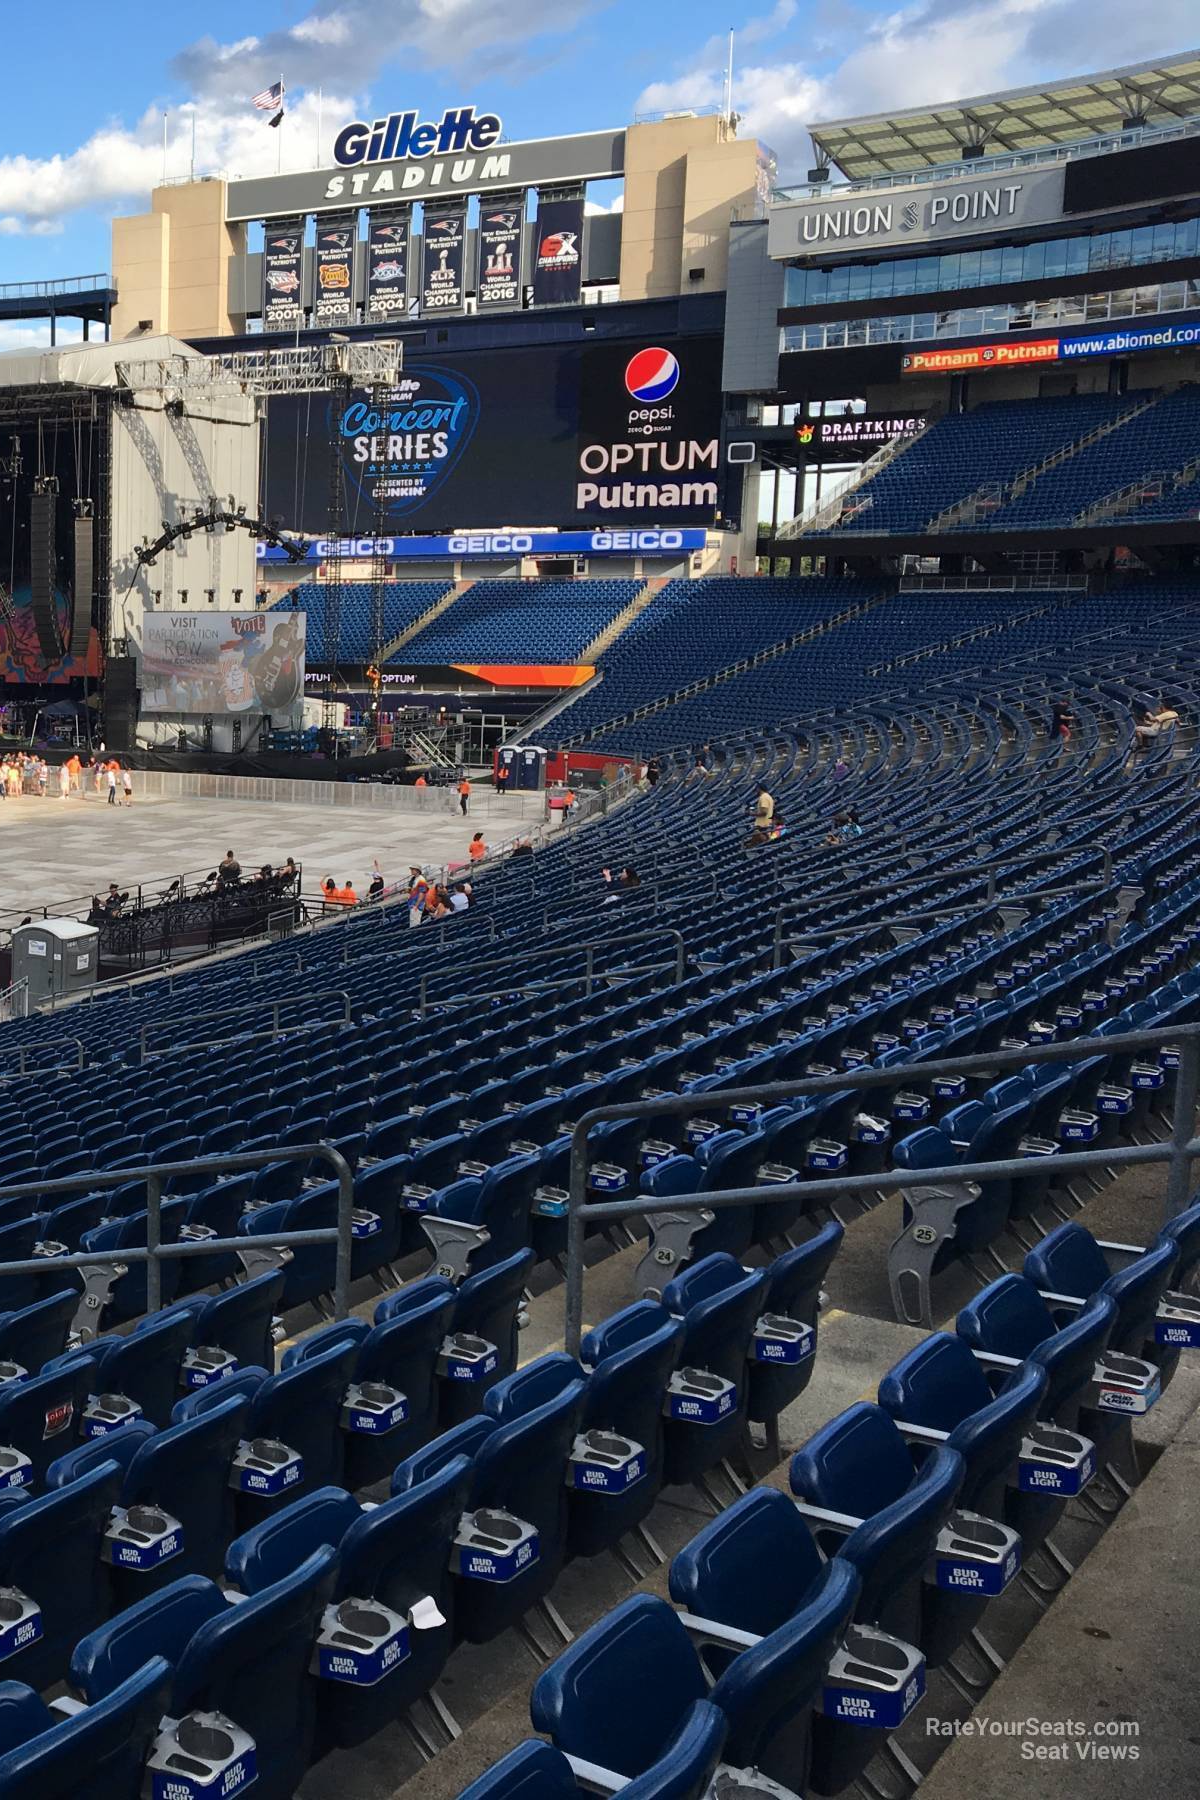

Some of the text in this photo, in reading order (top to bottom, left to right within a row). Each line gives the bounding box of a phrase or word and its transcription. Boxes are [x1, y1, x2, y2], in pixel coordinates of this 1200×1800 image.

[334, 105, 501, 167] Gillette
[325, 154, 511, 198] STADIUM
[802, 185, 1022, 242] UNION POINT
[486, 234, 515, 243] PATRIOTS
[430, 241, 457, 249] PATRIOTS
[374, 247, 402, 255] PATRIOTS
[270, 258, 296, 266] PATRIOTS
[322, 253, 348, 261] PATRIOTS
[538, 254, 578, 264] CHAMPIONS
[430, 271, 456, 282] XLIX
[480, 282, 518, 290] CHAMPIONS
[370, 292, 404, 300] CHAMPIONS
[424, 288, 460, 296] CHAMPIONS
[482, 288, 514, 300] 2016
[317, 297, 350, 306] CHAMPIONS
[426, 294, 458, 306] 2014
[266, 303, 298, 312] CHAMPIONS
[317, 304, 350, 316] 2003
[370, 300, 404, 312] 2004
[268, 310, 298, 320] 2001
[913, 351, 978, 368] Putnam
[343, 396, 468, 436] Concert
[628, 426, 642, 434] ZERO
[822, 418, 926, 435] DRAFTKINGS
[838, 434, 858, 442] GAME
[354, 432, 448, 462] SERIES
[580, 439, 718, 475] OPTUM
[414, 478, 424, 486] BY
[576, 481, 718, 509] Putnam
[316, 530, 682, 556] GEICO GEICO GEICO
[170, 617, 198, 628] VISIT
[235, 616, 265, 634] VOTE
[148, 628, 219, 640] PARTICIPATION
[164, 639, 202, 656] ROW
[382, 674, 415, 684] OPTUM
[916, 1230, 932, 1240] 25
[658, 1250, 671, 1262] 24
[440, 1267, 451, 1278] 23
[1168, 1328, 1188, 1336] BUD
[1164, 1334, 1192, 1342] LIGHT
[763, 1350, 786, 1358] LIGHT
[454, 1370, 474, 1379] LIGHT
[1106, 1398, 1136, 1406] LIGHT
[678, 1407, 702, 1416] LIGHT
[358, 1416, 374, 1424] BUD
[356, 1421, 376, 1430] LIGHT
[250, 1475, 266, 1483] BUD
[586, 1470, 604, 1478] BUD
[1034, 1470, 1058, 1480] BUD
[8, 1474, 24, 1487] LIGHT
[248, 1480, 269, 1490] LIGHT
[582, 1476, 608, 1486] LIGHT
[1030, 1478, 1062, 1488] LIGHT
[162, 1535, 176, 1548] BUD
[122, 1548, 138, 1558] BUD
[159, 1540, 178, 1557] LIGHT
[119, 1553, 141, 1564] LIGHT
[472, 1558, 492, 1566] BUD
[469, 1564, 496, 1574] LIGHT
[953, 1568, 978, 1578] BUD
[949, 1576, 984, 1587] LIGHT
[18, 1622, 32, 1636] BUD
[14, 1629, 36, 1646] LIGHT
[384, 1640, 398, 1656] BUD
[333, 1656, 354, 1666] BUD
[382, 1648, 400, 1669] LIGHT
[329, 1664, 358, 1675] LIGHT
[842, 1697, 870, 1708] BUD
[837, 1705, 876, 1718] LIGHT
[225, 1762, 242, 1782] BUD
[222, 1769, 246, 1796] LIGHT
[166, 1782, 190, 1795] BUD
